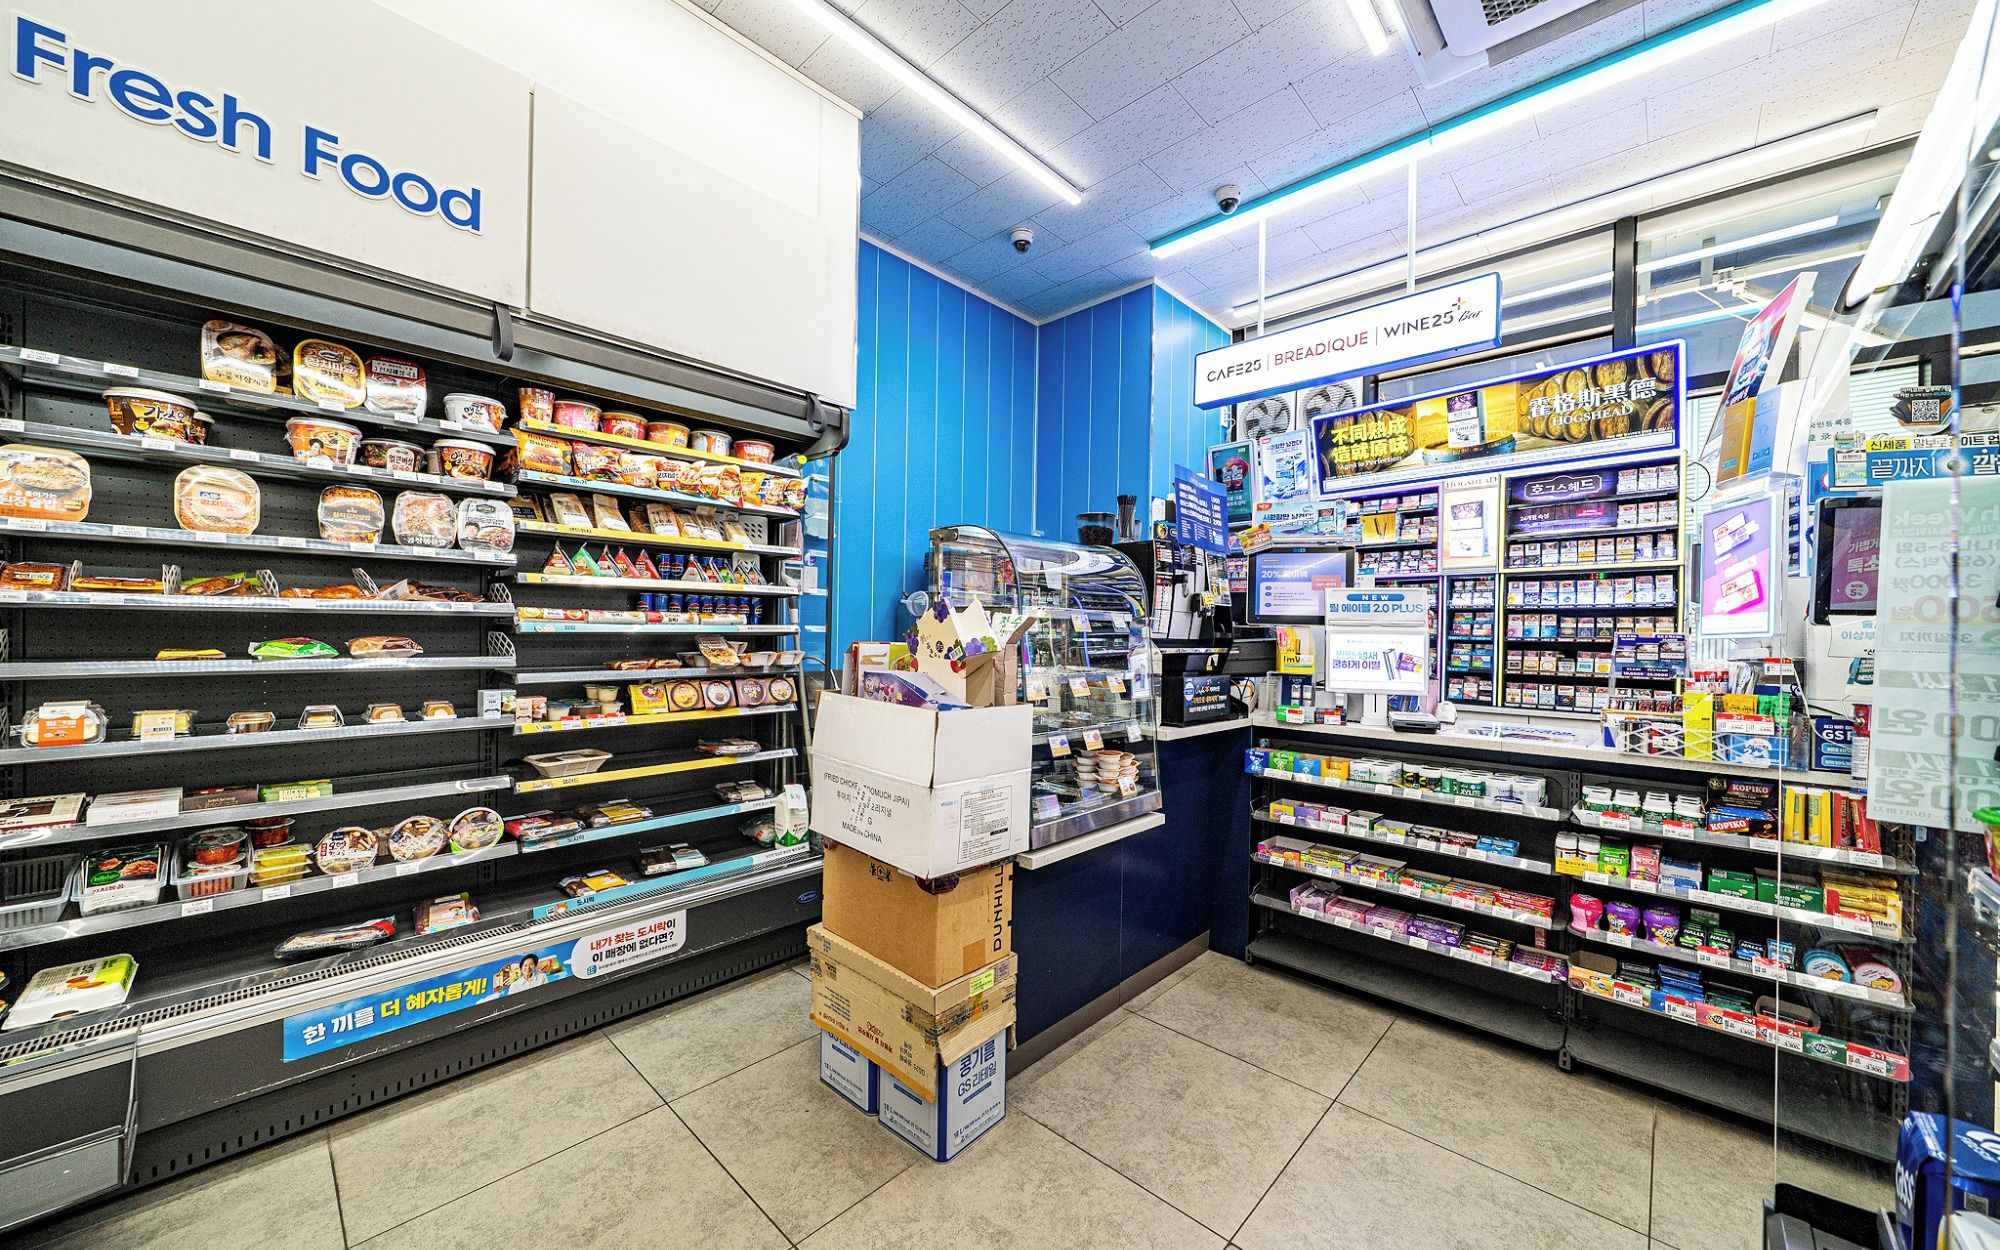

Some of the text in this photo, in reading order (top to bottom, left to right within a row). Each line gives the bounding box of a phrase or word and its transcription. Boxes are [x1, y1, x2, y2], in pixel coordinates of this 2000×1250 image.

[15, 14, 482, 232] Fresh Food
[1206, 309, 1483, 383] CAFE25 BREADIQUE WINE25 Bar
[1528, 377, 1657, 419] 霍格斯黑德
[1551, 405, 1634, 427] HOGSHEAD
[1331, 416, 1408, 446] 不同熟成
[1333, 435, 1409, 464] 造就原味
[1870, 440, 1908, 451] 신제품
[1913, 438, 1948, 449] 말보로
[1949, 436, 1985, 447] 이트
[1340, 461, 1357, 471] Aged
[1365, 454, 1404, 467] Perfection
[1871, 454, 2000, 479] 끝까지 깔
[1531, 478, 1596, 495] 호그스헤드
[1329, 604, 1424, 613] 릴 에이블 2.0 PLUS
[1821, 729, 1843, 741] GS
[824, 772, 839, 784] (FRIED
[840, 777, 861, 791] CHICKE
[1708, 778, 1728, 790] No.1
[1732, 783, 1769, 794] KOPIKO
[1618, 813, 1630, 821] 2+1
[1681, 821, 1694, 829] 2+1
[1710, 820, 1747, 832] KOPIKO
[842, 821, 857, 834] MADE
[863, 831, 882, 844] CHINA
[576, 896, 595, 906] 도시락
[799, 892, 818, 903] Carrier
[993, 864, 1006, 952] DUNHILL
[1855, 914, 1870, 922] 2+1
[1870, 918, 1898, 930] erther's
[590, 918, 677, 951] 내가 찾는 도시락이
[1683, 928, 1705, 938] HALLS
[1709, 933, 1733, 944] HALLS
[592, 931, 675, 963] 이 매장에 없다면?
[1715, 949, 1730, 957] 2+1
[1740, 942, 1764, 952] HALLS
[1631, 986, 1643, 995] 2+1
[1685, 1001, 1696, 1009] 2+1
[303, 977, 488, 1046] 한 끼를 더 혜자롭게!
[1742, 1016, 1756, 1025] 2+1
[1788, 1029, 1802, 1038] 2+1
[1806, 1041, 1838, 1056] eclipse
[959, 1039, 996, 1078] 콩기름
[1869, 1050, 1885, 1061] 2+1
[957, 1061, 998, 1097] GS 리테일
